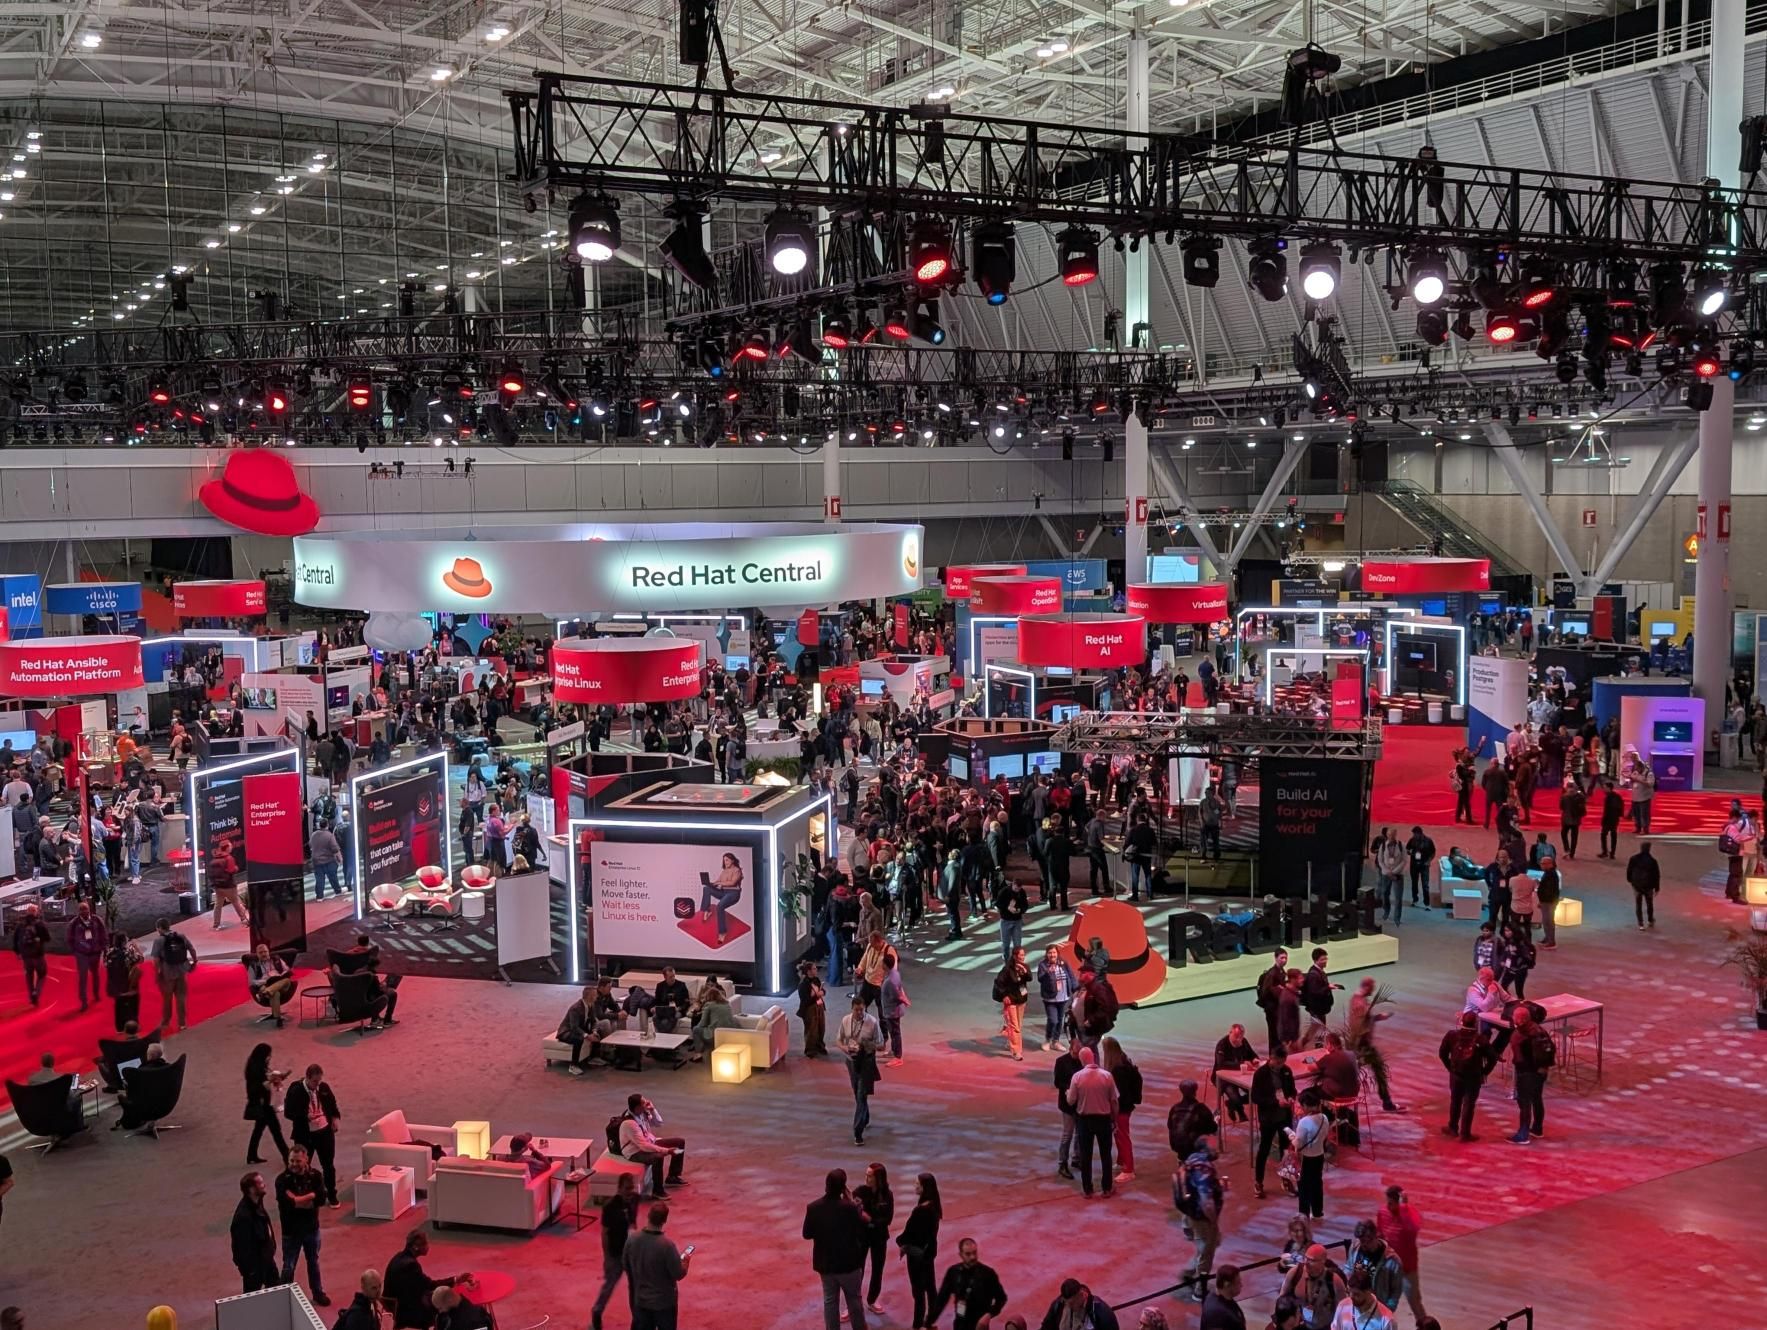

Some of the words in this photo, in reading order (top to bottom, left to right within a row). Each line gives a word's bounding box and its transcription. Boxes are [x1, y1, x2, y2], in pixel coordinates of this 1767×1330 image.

[302, 562, 334, 584] Central
[631, 564, 684, 588] Red
[691, 565, 736, 586] Hat
[741, 561, 821, 584] Central
[1067, 569, 1086, 578] aws
[1368, 574, 1396, 582] DevZone
[11, 592, 36, 608] intel
[1086, 635, 1105, 646] Red
[1107, 634, 1123, 644] Hat
[1100, 646, 1111, 656] AI
[21, 660, 40, 670] Red
[43, 659, 64, 669] Hat
[66, 657, 108, 668] Ansible
[565, 664, 579, 674] Hat
[681, 661, 694, 671] Red
[10, 671, 71, 682] Automation
[74, 670, 121, 680] Platform
[1472, 668, 1499, 677] Production
[574, 678, 601, 689] Linux
[1277, 789, 1310, 800] Build
[1313, 789, 1327, 800] AI
[250, 810, 286, 818] Enterprise
[1277, 805, 1296, 816] for
[1301, 808, 1332, 819] your
[210, 818, 226, 830] Think
[1277, 823, 1316, 834] world
[370, 848, 381, 859] that
[382, 845, 392, 856] can
[392, 840, 404, 850] take
[370, 862, 381, 874] you
[381, 854, 400, 868] further
[601, 878, 618, 887] Feel
[620, 880, 648, 890] lighter.
[602, 890, 623, 898] Move
[625, 890, 650, 900] faster.
[602, 901, 620, 909] Wait
[622, 902, 640, 910] less
[602, 911, 626, 920] Linux
[628, 912, 635, 921] is
[636, 913, 659, 922] here.
